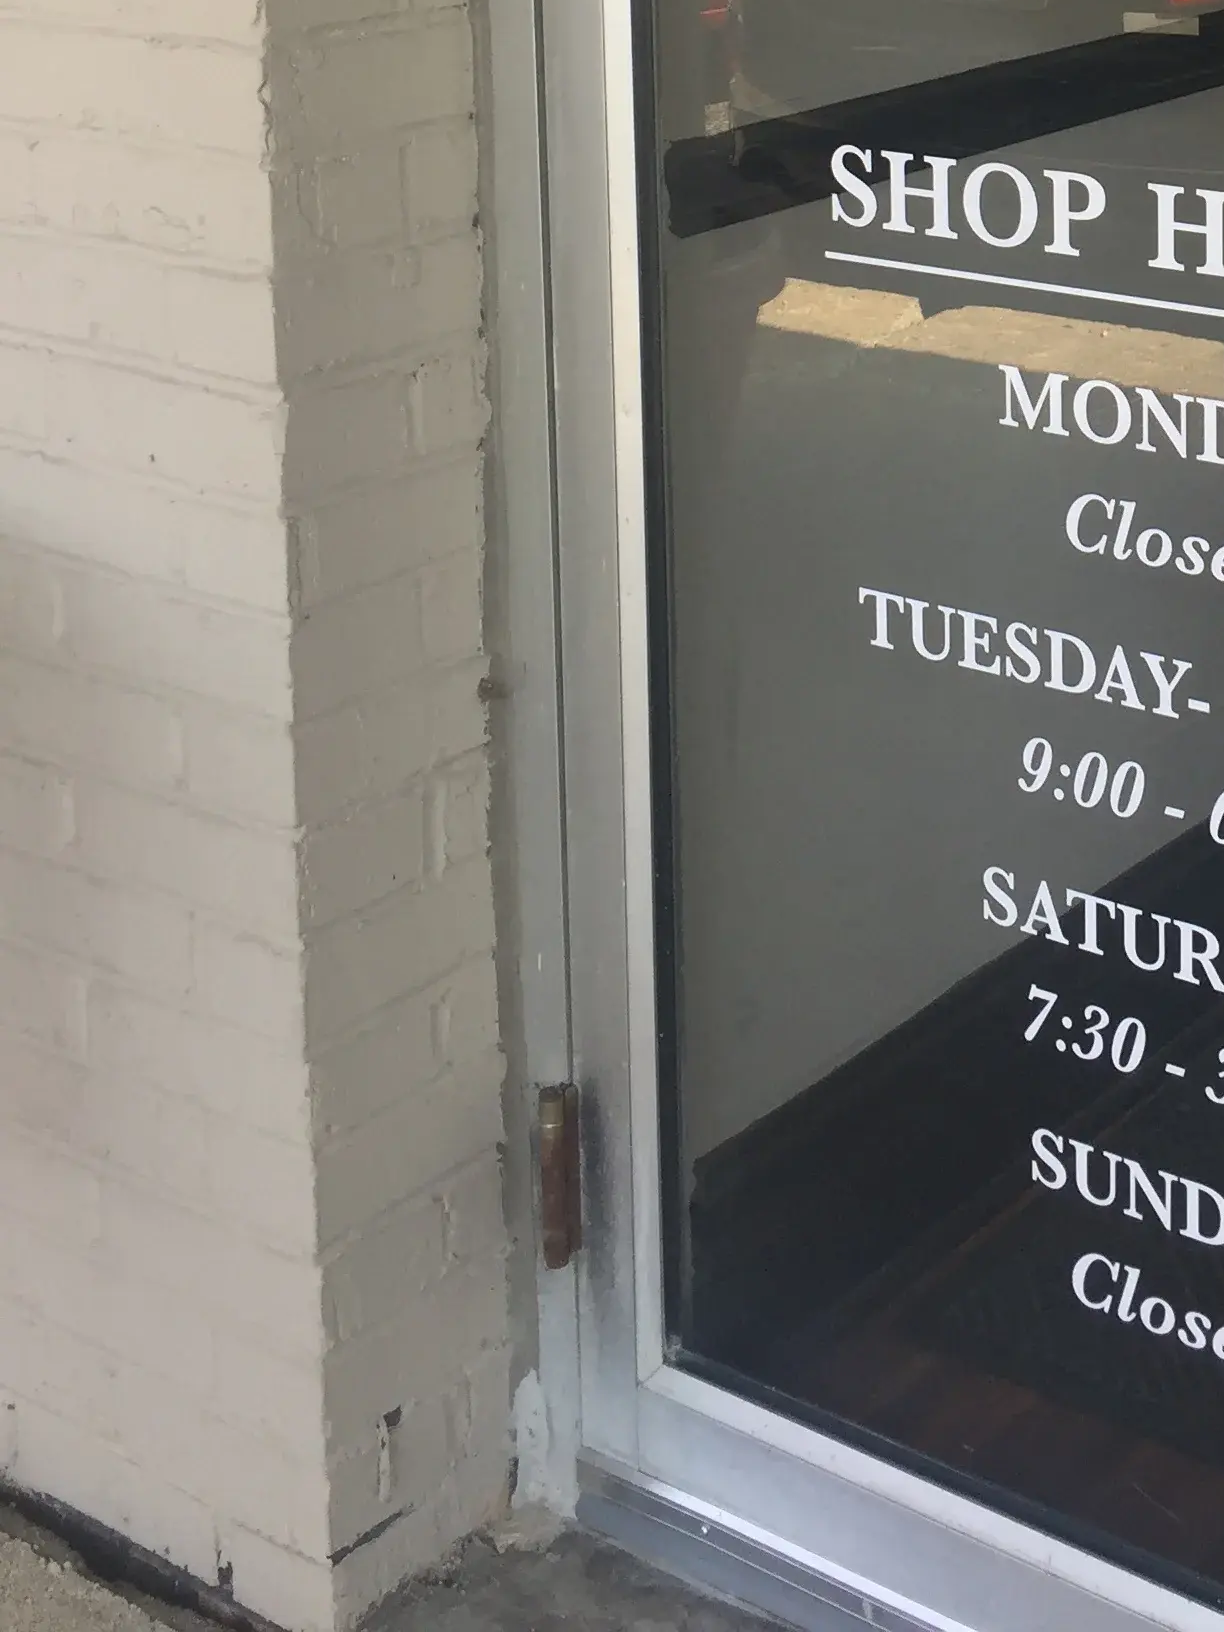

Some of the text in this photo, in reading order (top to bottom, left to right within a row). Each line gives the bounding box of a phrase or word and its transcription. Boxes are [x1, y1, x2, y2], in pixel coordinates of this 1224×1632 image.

[831, 145, 1105, 256] SHOP
[1018, 738, 1144, 817] 9:00
[1164, 806, 1184, 819] -
[1025, 984, 1145, 1072] 7:30
[1165, 1064, 1185, 1076] -
